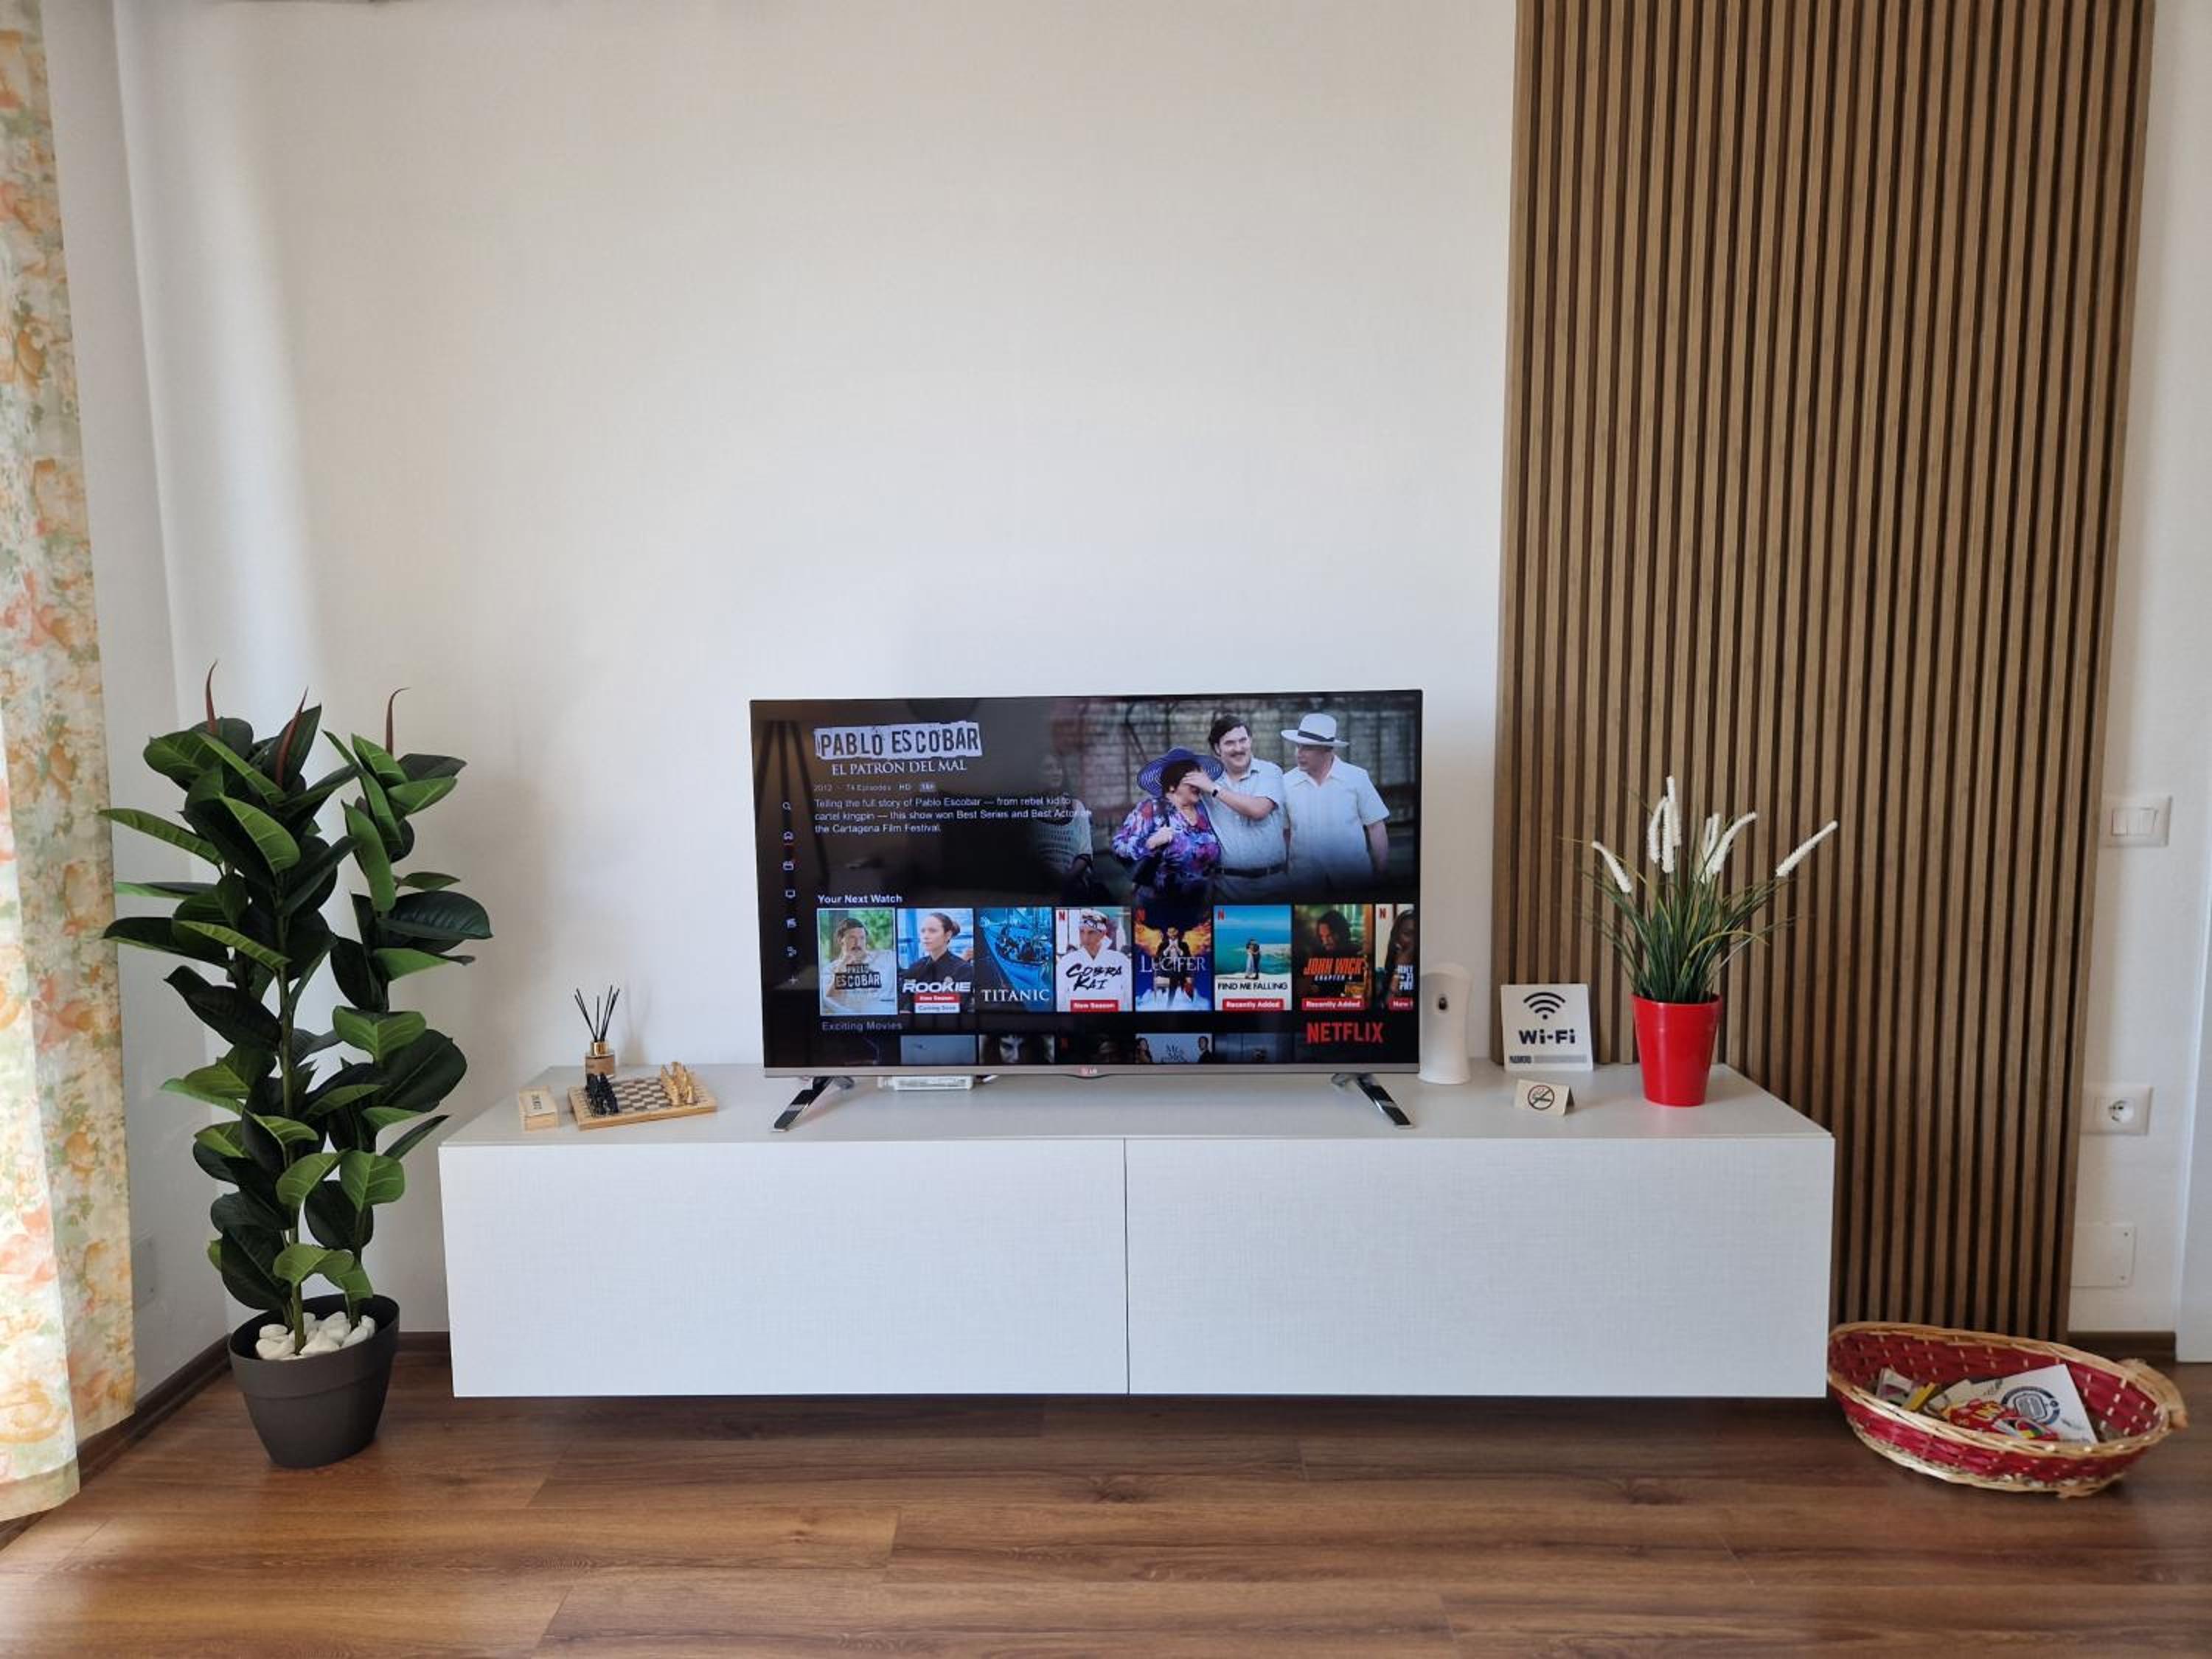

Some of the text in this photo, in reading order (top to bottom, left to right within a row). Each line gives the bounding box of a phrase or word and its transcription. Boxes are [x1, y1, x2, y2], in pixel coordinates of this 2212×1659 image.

[821, 726, 979, 757] PABLO ESCOBAR
[832, 763, 846, 776] EL
[909, 760, 936, 773] DEL
[938, 759, 967, 772] MAL
[899, 783, 912, 791] HD
[814, 799, 843, 808] Telling
[845, 799, 860, 807] the
[878, 799, 900, 809] story
[903, 798, 913, 807] of
[915, 797, 942, 807] Pablo
[943, 797, 981, 807] Escobar
[997, 796, 1018, 806] from
[1020, 796, 1044, 806] rebel
[1046, 796, 1060, 805] kid
[1061, 796, 1071, 804] to
[814, 812, 841, 821] cartel
[843, 812, 875, 822] kingpin
[890, 811, 907, 820] this
[909, 811, 932, 819] show
[956, 810, 978, 819] Best
[980, 810, 1009, 818] Series
[1011, 810, 1029, 818] and
[1032, 809, 1052, 818] Best
[815, 824, 830, 833] the
[832, 824, 880, 835] Cartagena
[883, 824, 902, 833] Film
[817, 893, 903, 904] Your Next Watch
[1138, 954, 1207, 973] LUCIFER
[1303, 957, 1364, 975] JOHN WICK
[1065, 963, 1123, 978] COBRA
[835, 973, 880, 988] ESCOBAR
[902, 981, 972, 993] ROOKIE
[1073, 975, 1109, 992] KAI
[1217, 981, 1288, 991] FIND ME FALLING
[980, 989, 1051, 1003] TITANIC
[1225, 1000, 1281, 1010] Recently Added
[1306, 1000, 1361, 1009] Recently Added
[821, 1020, 903, 1032] Exciting Movies
[1307, 1021, 1384, 1044] NETFLIX
[1518, 1028, 1576, 1045] Wi-Fi
